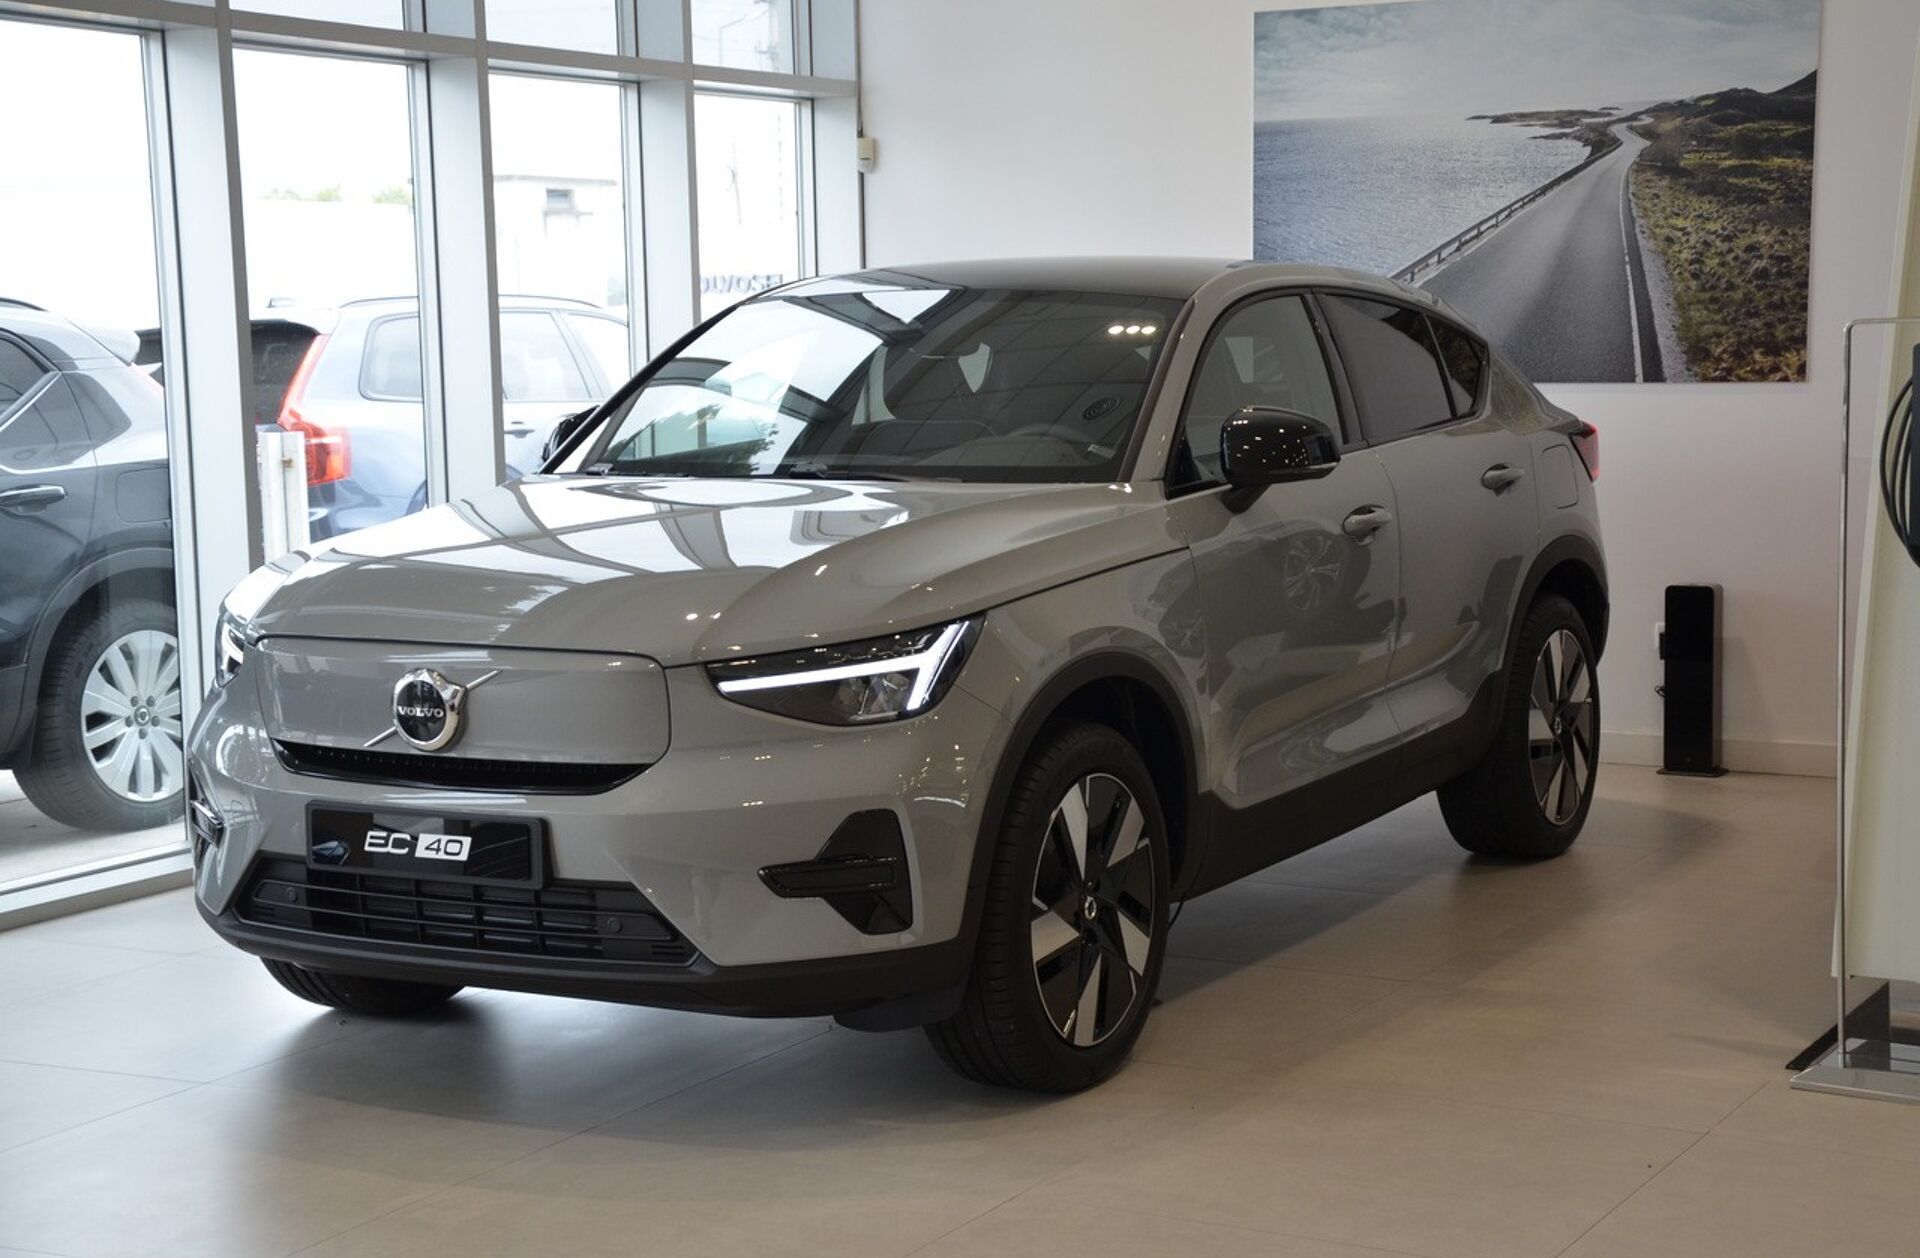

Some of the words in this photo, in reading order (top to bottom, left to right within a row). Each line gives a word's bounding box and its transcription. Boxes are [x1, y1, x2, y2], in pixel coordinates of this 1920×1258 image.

[398, 705, 445, 718] VOLVO
[364, 830, 412, 855] EC
[422, 837, 465, 857] 40
